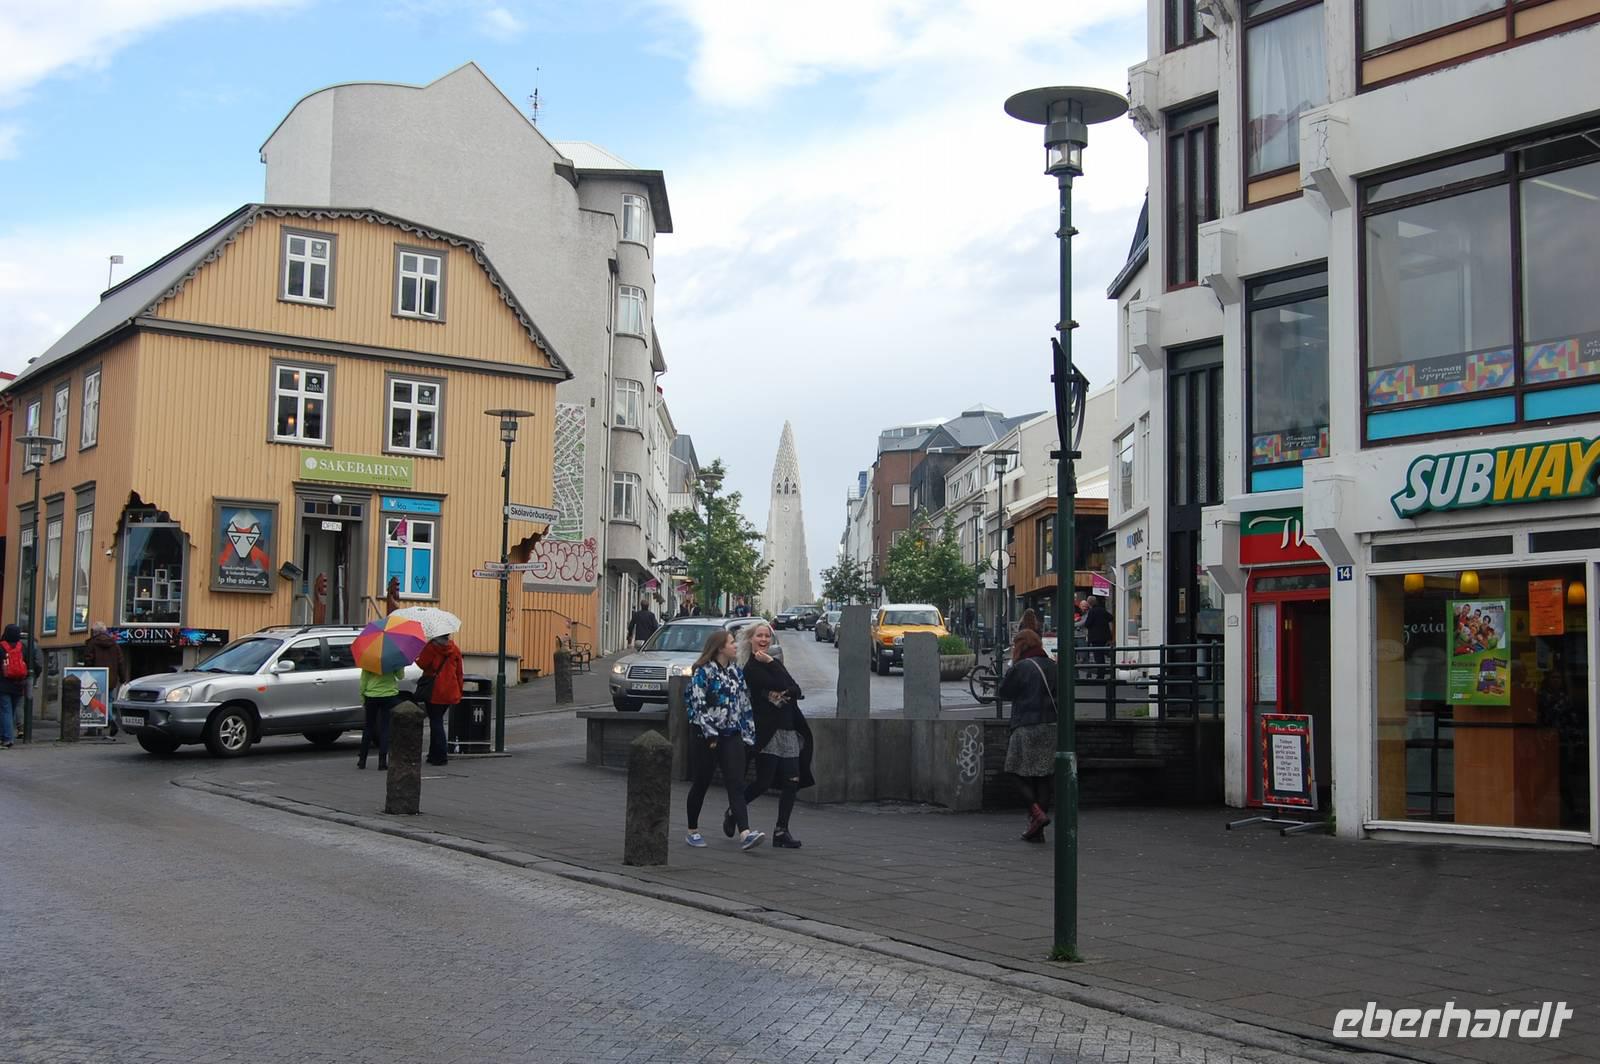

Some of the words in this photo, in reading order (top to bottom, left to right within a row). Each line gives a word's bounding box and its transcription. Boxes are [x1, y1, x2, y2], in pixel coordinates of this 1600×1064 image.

[319, 459, 409, 477] SAKEBARINN
[1393, 438, 1600, 512] SUBWAY
[322, 522, 342, 530] OPEN
[1339, 568, 1351, 579] 14
[226, 576, 237, 584] the
[238, 577, 256, 585] stairs
